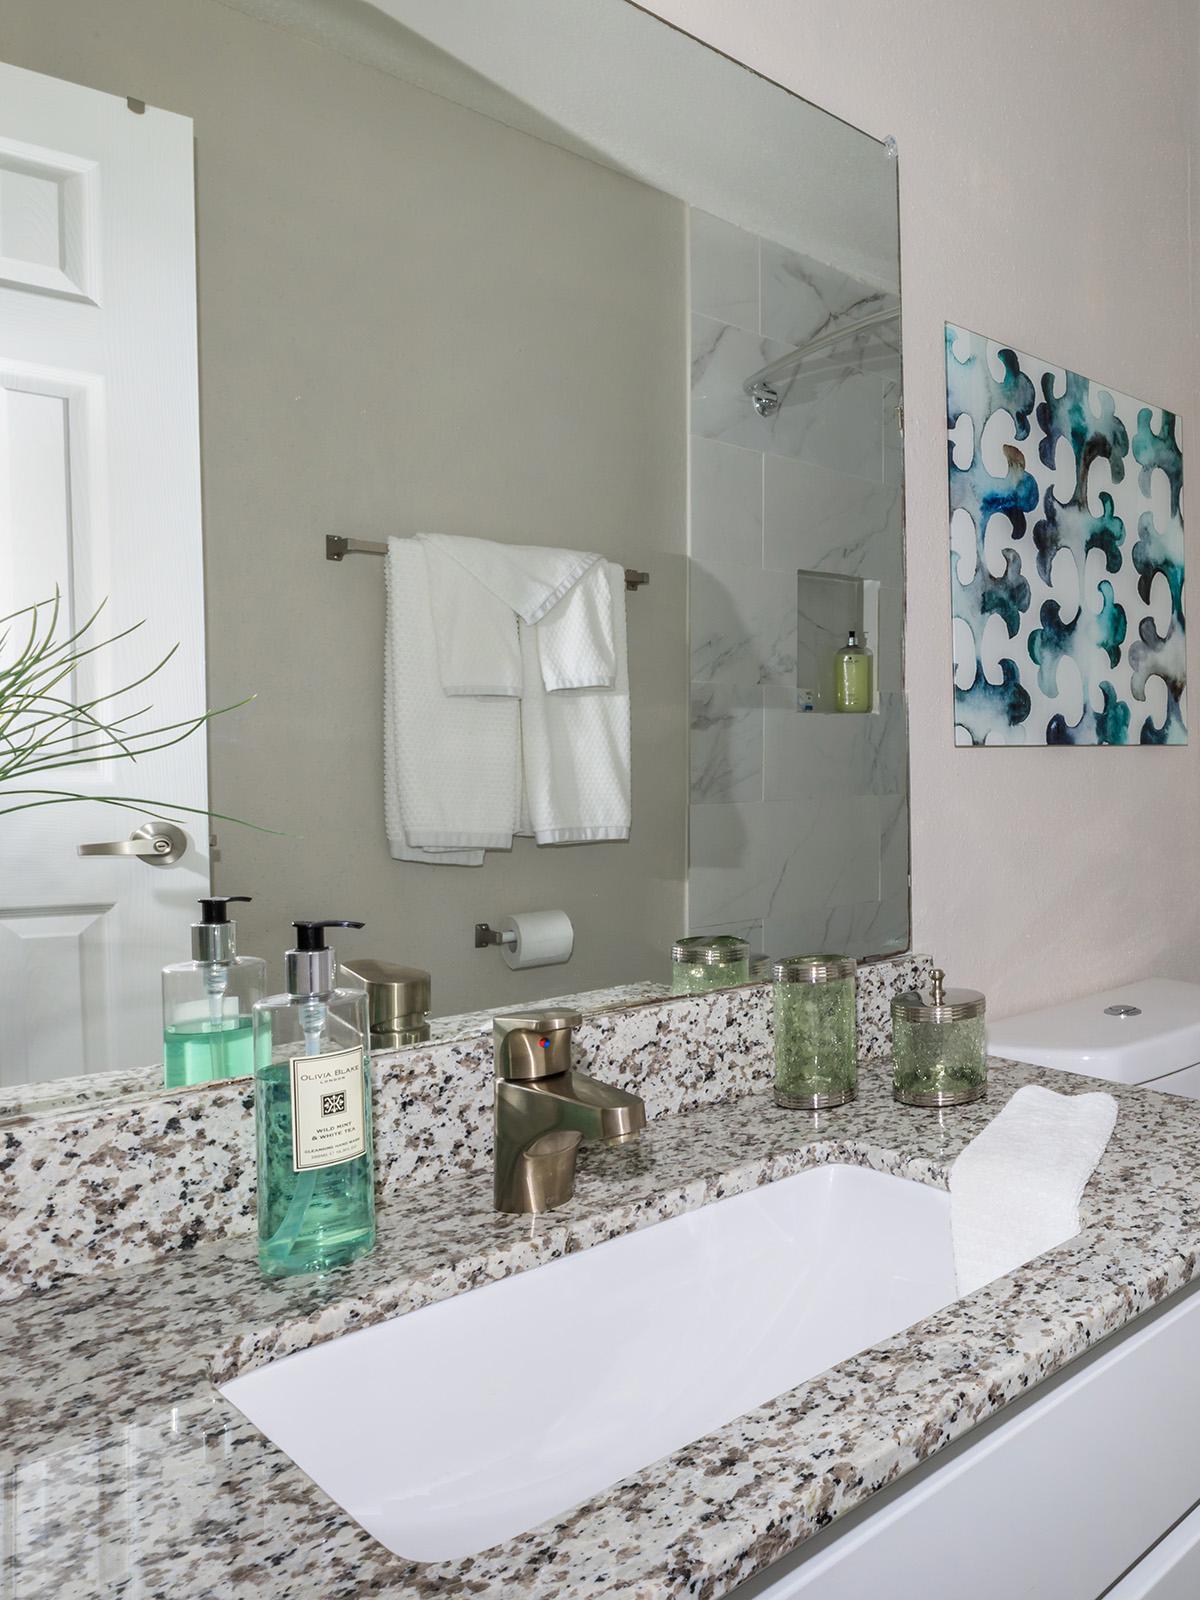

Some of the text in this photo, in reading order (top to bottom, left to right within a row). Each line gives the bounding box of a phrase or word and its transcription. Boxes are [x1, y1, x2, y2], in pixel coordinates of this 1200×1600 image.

[300, 1065, 359, 1081] OLIVIA BLAKE
[320, 1131, 341, 1139] WHITE
